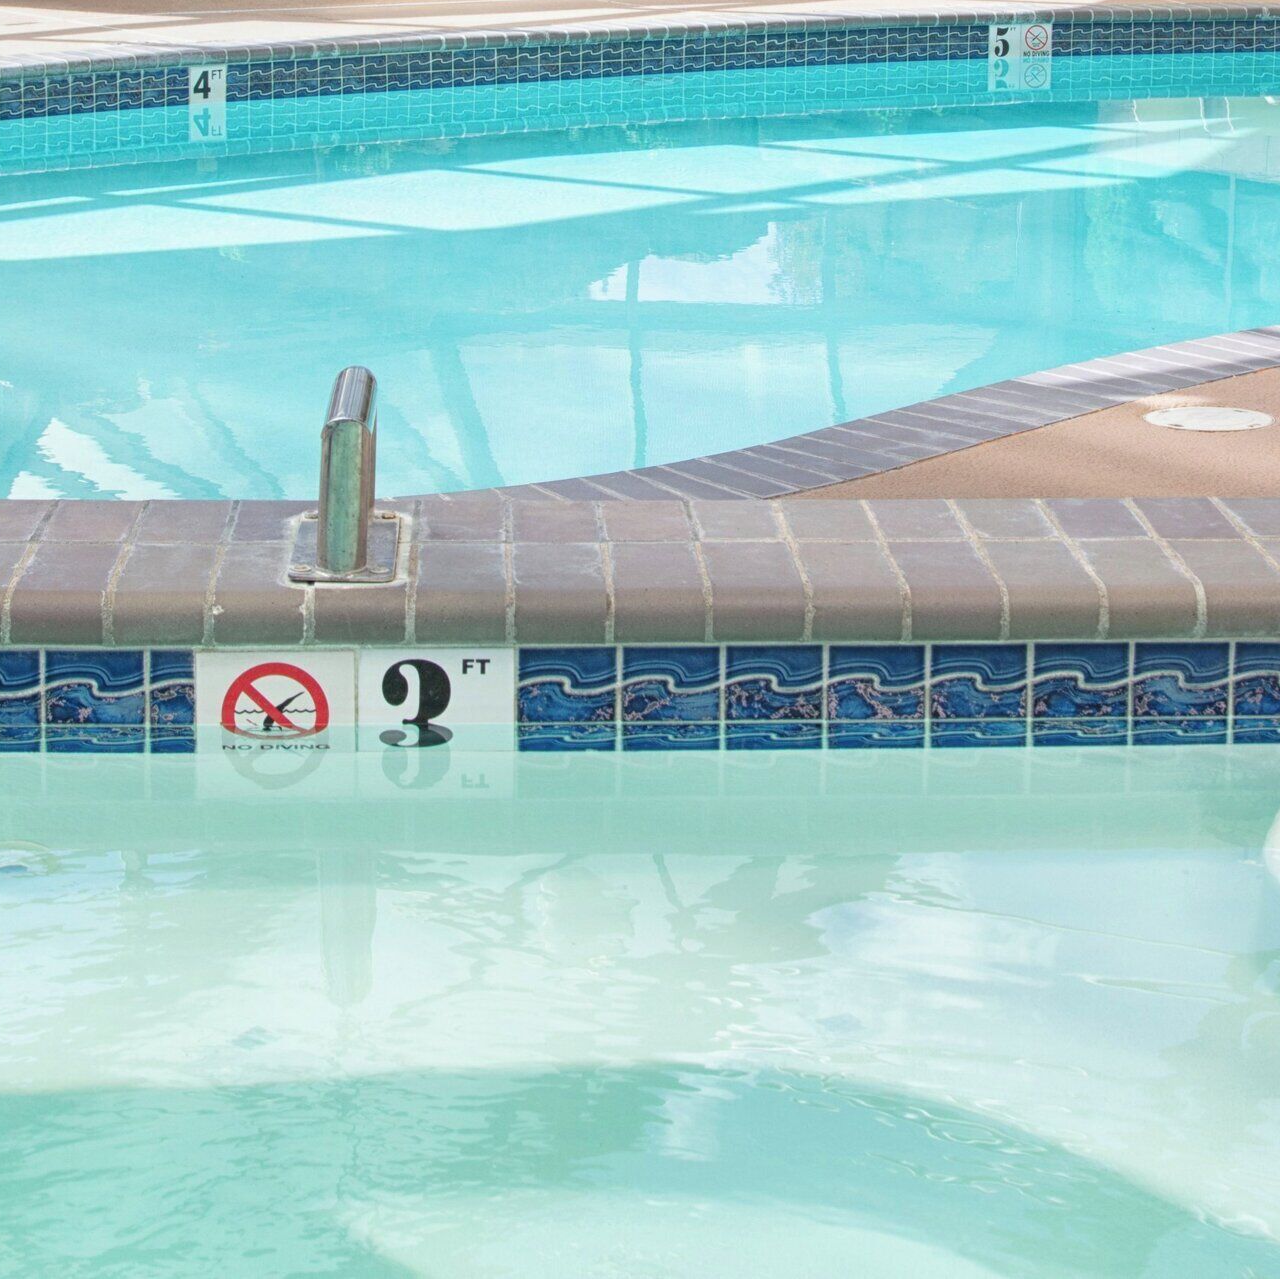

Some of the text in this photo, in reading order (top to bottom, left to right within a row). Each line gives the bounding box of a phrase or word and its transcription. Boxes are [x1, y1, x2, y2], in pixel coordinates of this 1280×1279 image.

[994, 27, 1010, 57] 5
[193, 69, 223, 99] 4 FT
[379, 658, 491, 748] 3 FT
[222, 743, 331, 751] NO DIVING
